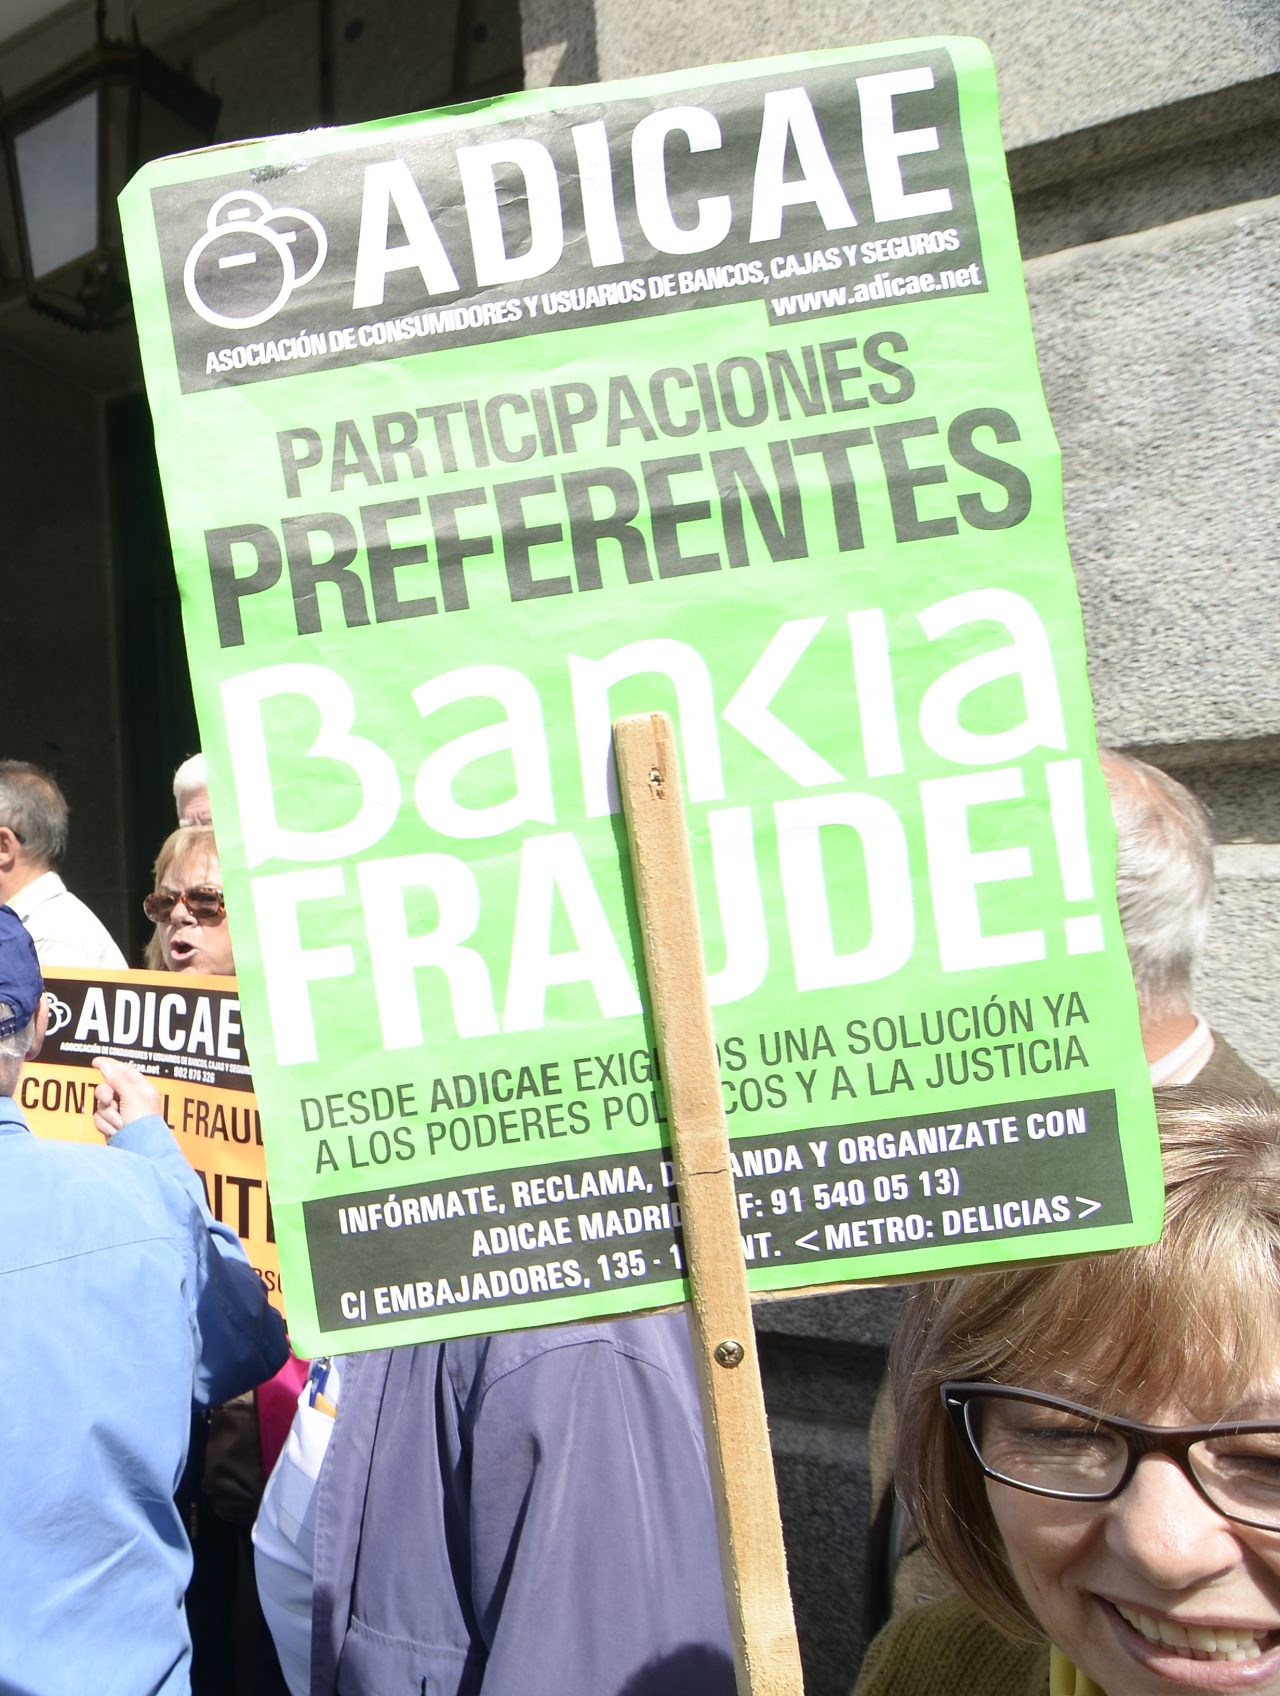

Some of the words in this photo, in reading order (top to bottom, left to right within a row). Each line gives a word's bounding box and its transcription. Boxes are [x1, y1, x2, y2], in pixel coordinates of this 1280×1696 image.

[352, 65, 953, 311] ADICAE
[205, 329, 328, 375] ASOCIACIÓN
[329, 326, 358, 353] DE
[358, 297, 523, 348] CONSUMIDORES
[523, 295, 539, 318] Y
[544, 276, 648, 317] USUARIOS
[648, 271, 678, 300] DE
[679, 260, 771, 296] BANCOS,
[770, 246, 842, 279] CAJAS
[840, 244, 862, 268] Y
[862, 227, 961, 266] SEGUROS
[770, 263, 983, 318] www.adicae.net
[276, 331, 916, 499] PARTICIPACIONES
[202, 407, 1033, 649] PREFERENTES
[74, 986, 242, 1061] ADICAE
[300, 1082, 419, 1132] DESDE
[429, 1061, 564, 1113] ADICAE
[758, 1024, 836, 1068] UNA
[845, 993, 1034, 1056] SOLUCIÓN
[1042, 990, 1090, 1028] YA
[315, 1139, 340, 1175] A
[347, 1126, 416, 1169] LOS
[426, 1099, 591, 1156] PODERES
[794, 1070, 818, 1105] Y
[830, 1065, 858, 1101] A
[866, 1056, 915, 1097] LA
[925, 1033, 1090, 1090] JUSTICIA
[337, 1184, 507, 1236] INFÓRMATE,
[510, 1165, 654, 1209] RECLAMA,
[808, 1140, 829, 1169] Y
[837, 1115, 1019, 1165] ORGANIZATE
[1025, 1106, 1088, 1138] CON
[372, 1258, 592, 1315] EMBAJADORES,
[596, 1249, 647, 1283] 135
[471, 1216, 573, 1259] ADICAE
[770, 1187, 804, 1216] 91
[813, 1179, 867, 1211] 540
[872, 1172, 909, 1202] 05
[917, 1166, 961, 1197] 13)
